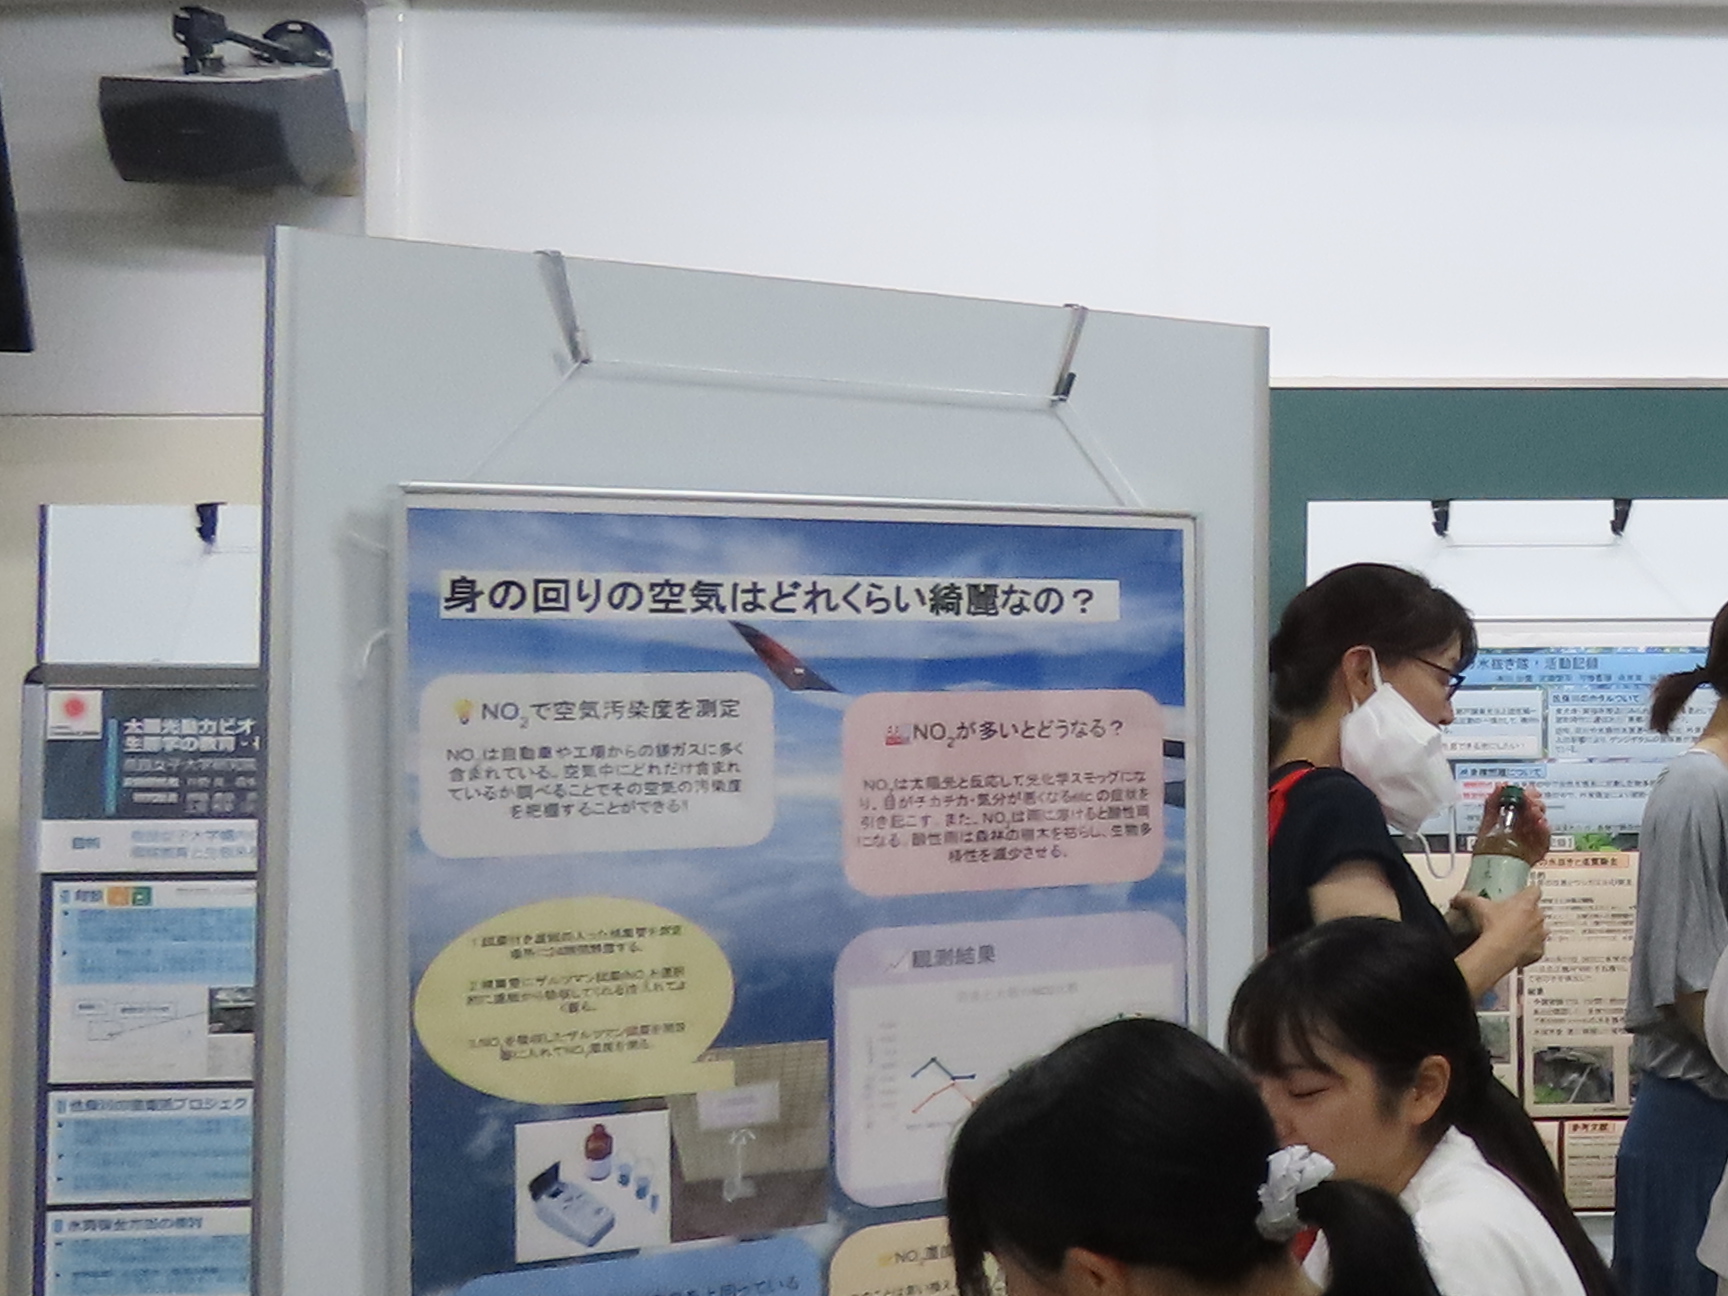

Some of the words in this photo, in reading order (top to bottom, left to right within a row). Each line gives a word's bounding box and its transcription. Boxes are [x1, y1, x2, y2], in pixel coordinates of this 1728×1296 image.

[444, 574, 1094, 616] 身の回りの空気はどれくらい綺麗なの？
